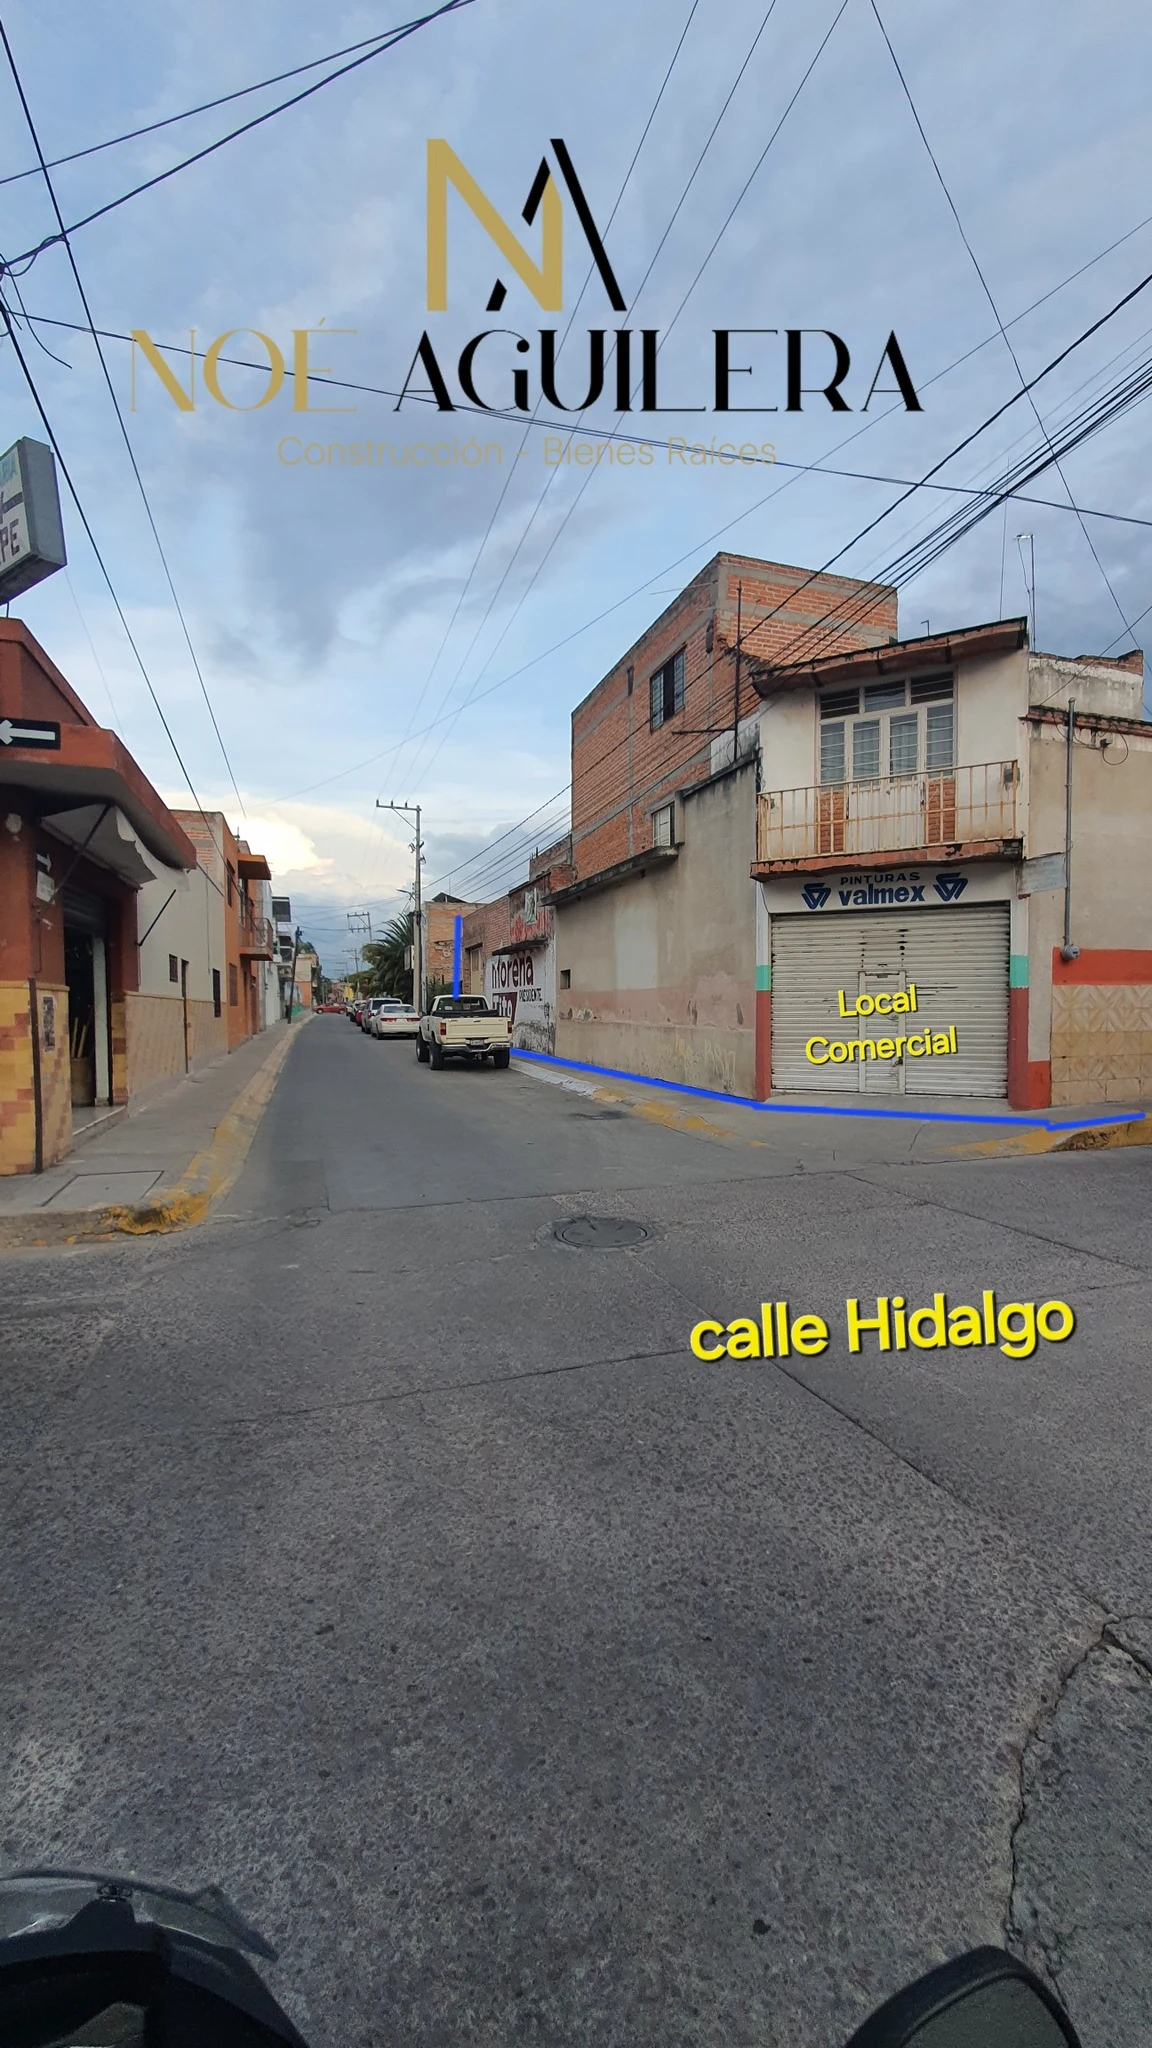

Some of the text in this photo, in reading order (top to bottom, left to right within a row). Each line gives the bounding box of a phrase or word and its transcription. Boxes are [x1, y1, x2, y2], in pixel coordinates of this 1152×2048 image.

[0, 518, 20, 564] PE
[840, 872, 920, 885] PINTURAS
[838, 884, 926, 906] valmex
